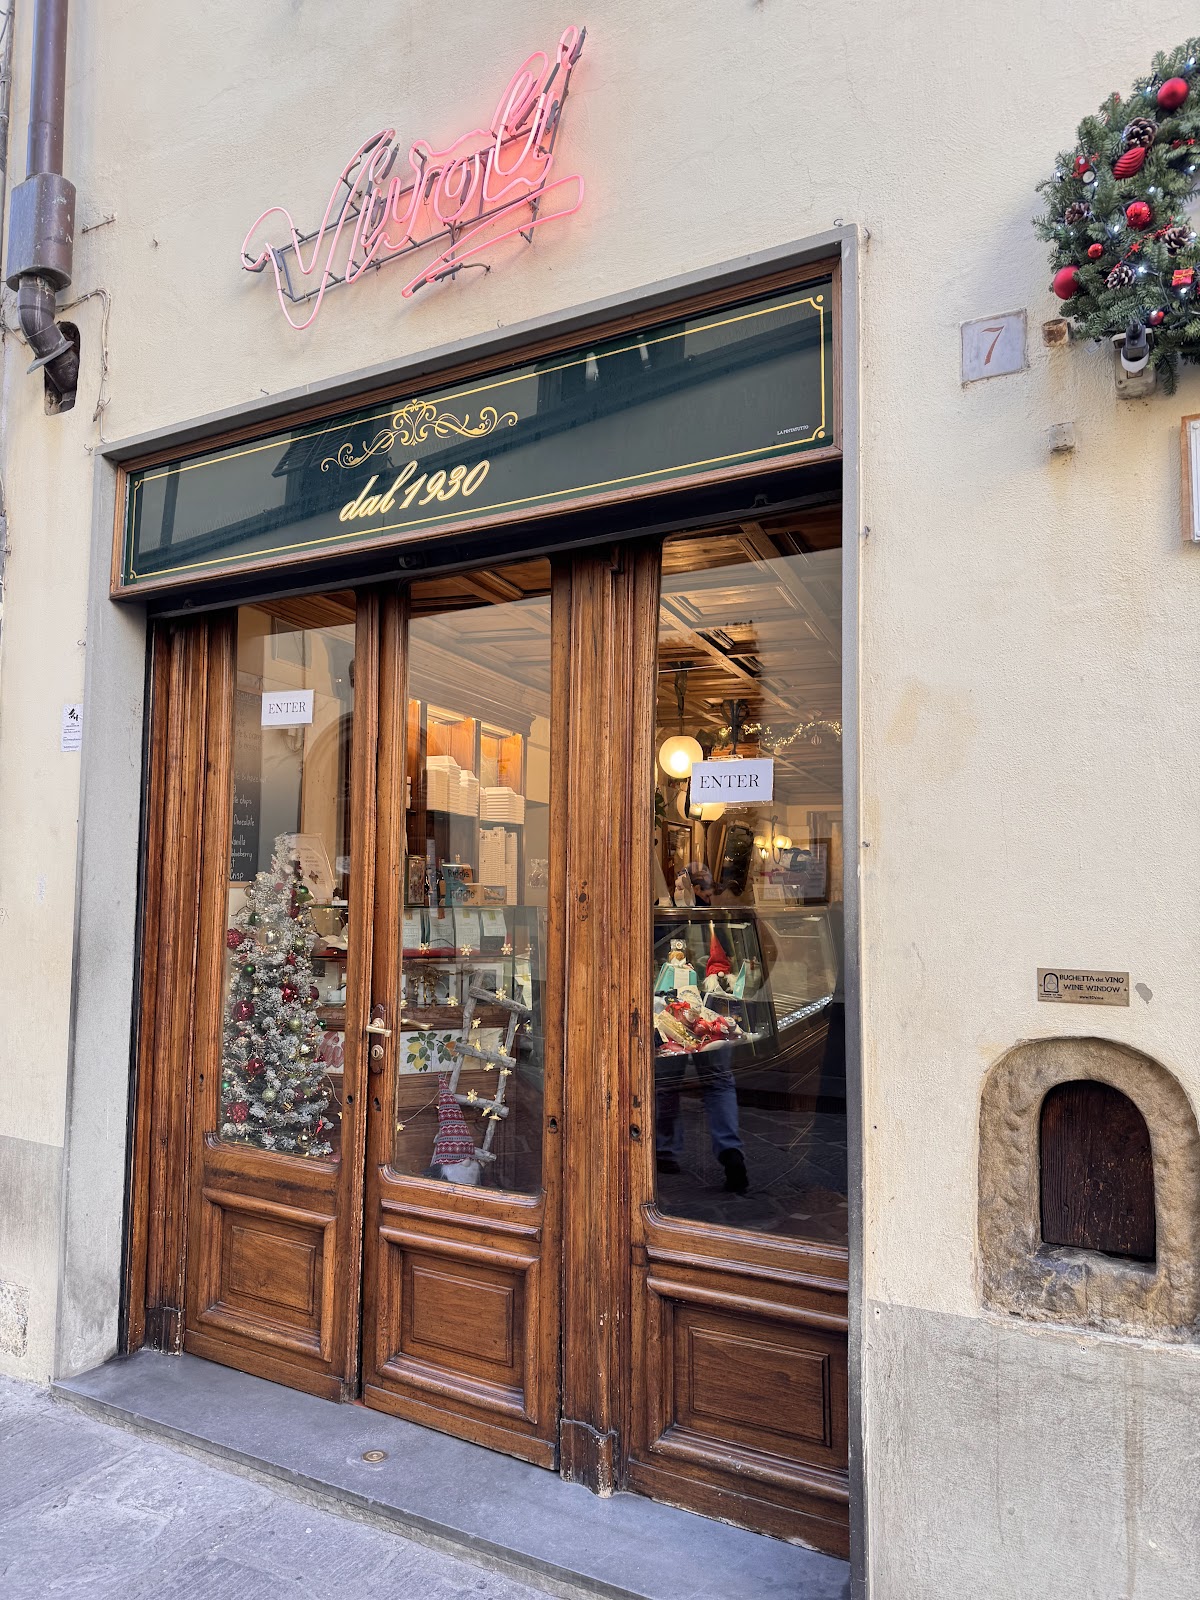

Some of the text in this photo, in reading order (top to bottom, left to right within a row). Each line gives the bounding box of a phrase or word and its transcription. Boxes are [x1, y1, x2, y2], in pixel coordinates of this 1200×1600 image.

[981, 325, 1005, 366] 7
[339, 459, 491, 522] dal 1930
[268, 701, 307, 715] ENTER
[699, 773, 760, 789] ENTER
[1059, 974, 1095, 982] BUCHETTA
[1063, 983, 1121, 993] WINE WINDOW
